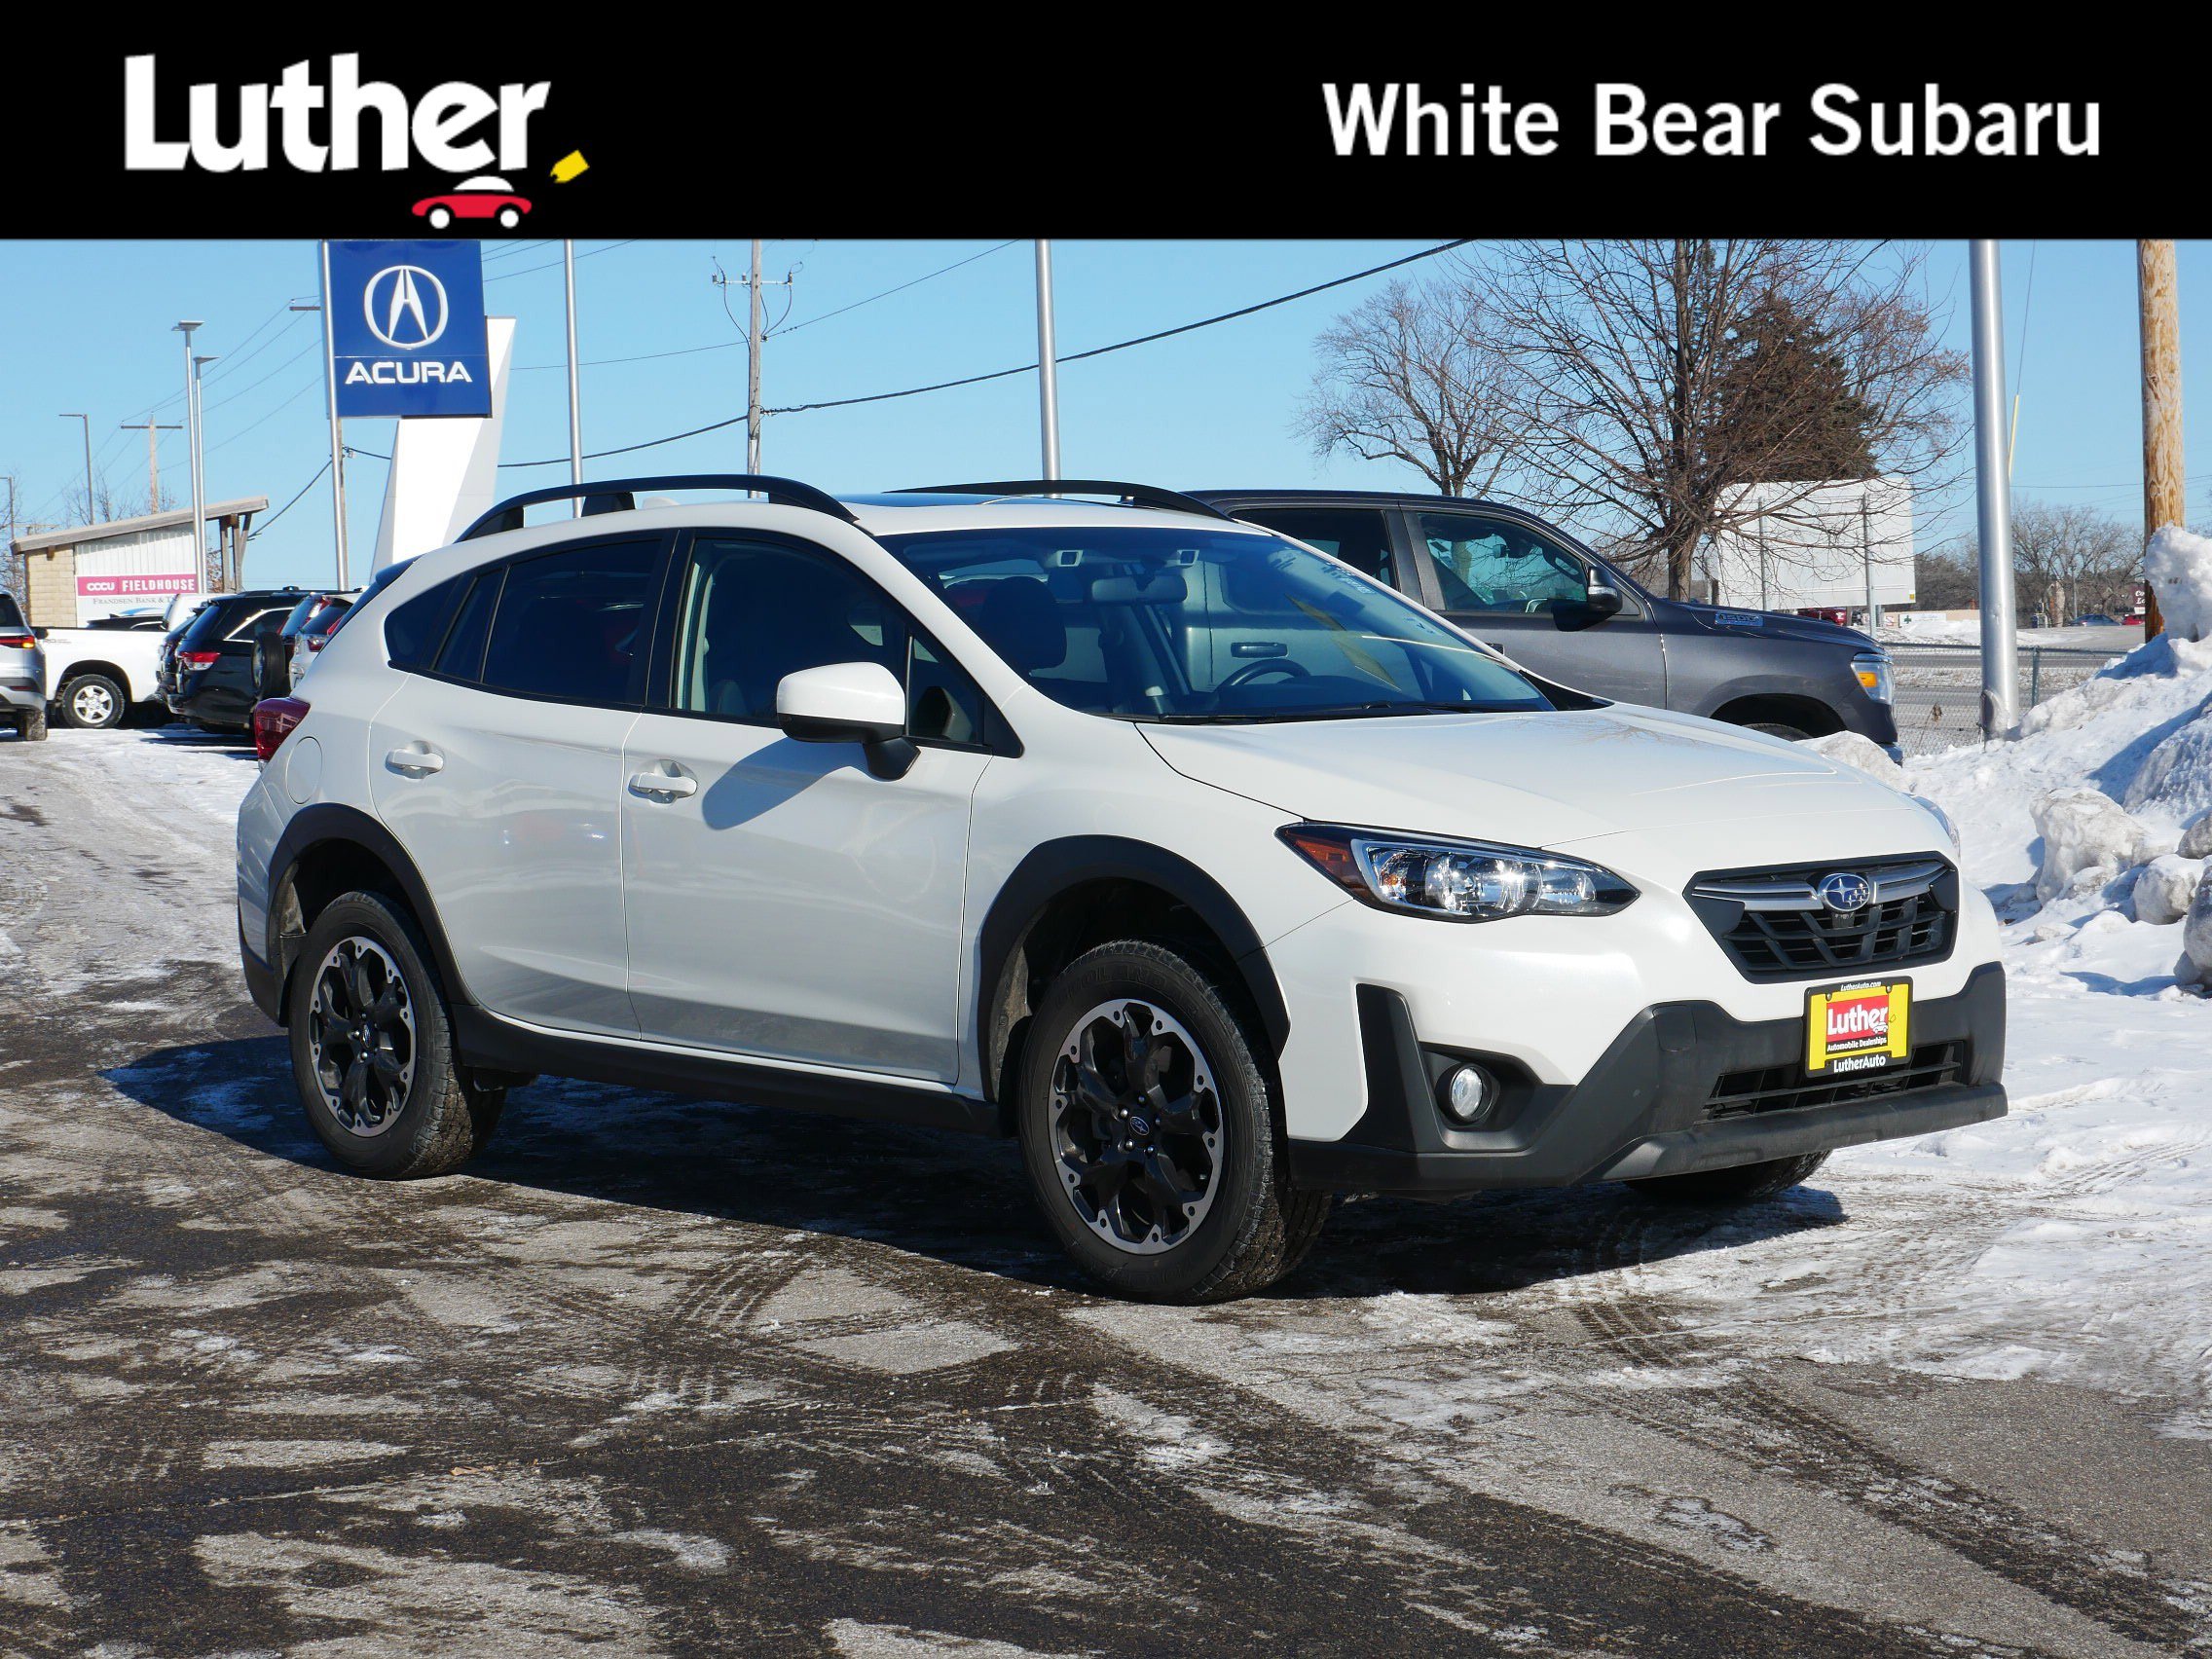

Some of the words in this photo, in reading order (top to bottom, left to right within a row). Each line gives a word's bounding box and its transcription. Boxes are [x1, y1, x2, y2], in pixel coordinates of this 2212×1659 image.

[345, 361, 473, 385] ACURA
[122, 578, 195, 592] FIELDHOUSE
[1840, 981, 1882, 992] LutherAuto.com
[1827, 1004, 1889, 1035] Luther
[1826, 1040, 1859, 1051] Automobile
[1860, 1037, 1887, 1047] Dealerships
[1833, 1054, 1886, 1073] LutherAuto
